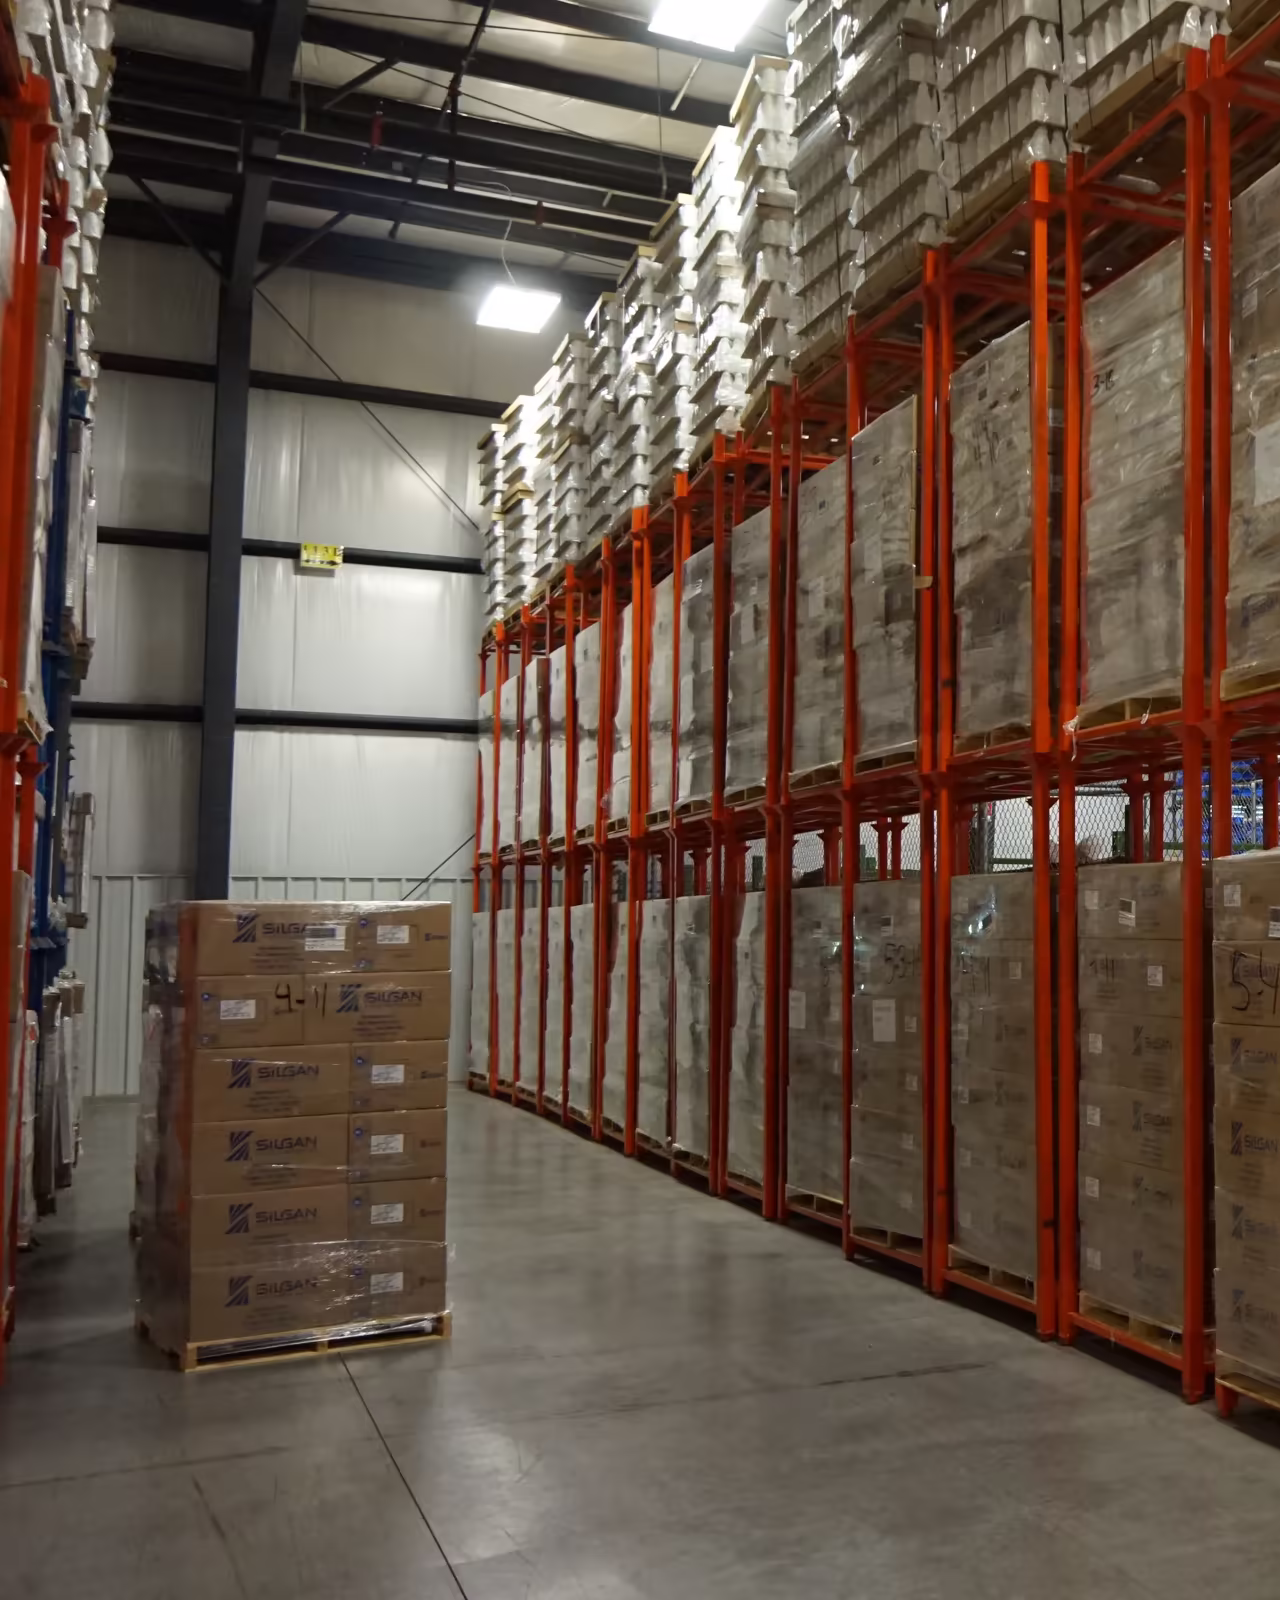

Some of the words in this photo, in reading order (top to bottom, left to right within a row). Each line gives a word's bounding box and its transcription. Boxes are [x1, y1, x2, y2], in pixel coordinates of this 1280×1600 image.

[262, 922, 310, 935] SILGA
[364, 991, 423, 1004] SILGAN
[257, 1065, 319, 1079] SILGAN
[256, 1136, 318, 1151] SILGAN
[255, 1207, 318, 1223] SILGAN
[255, 1278, 319, 1296] SILGAN
